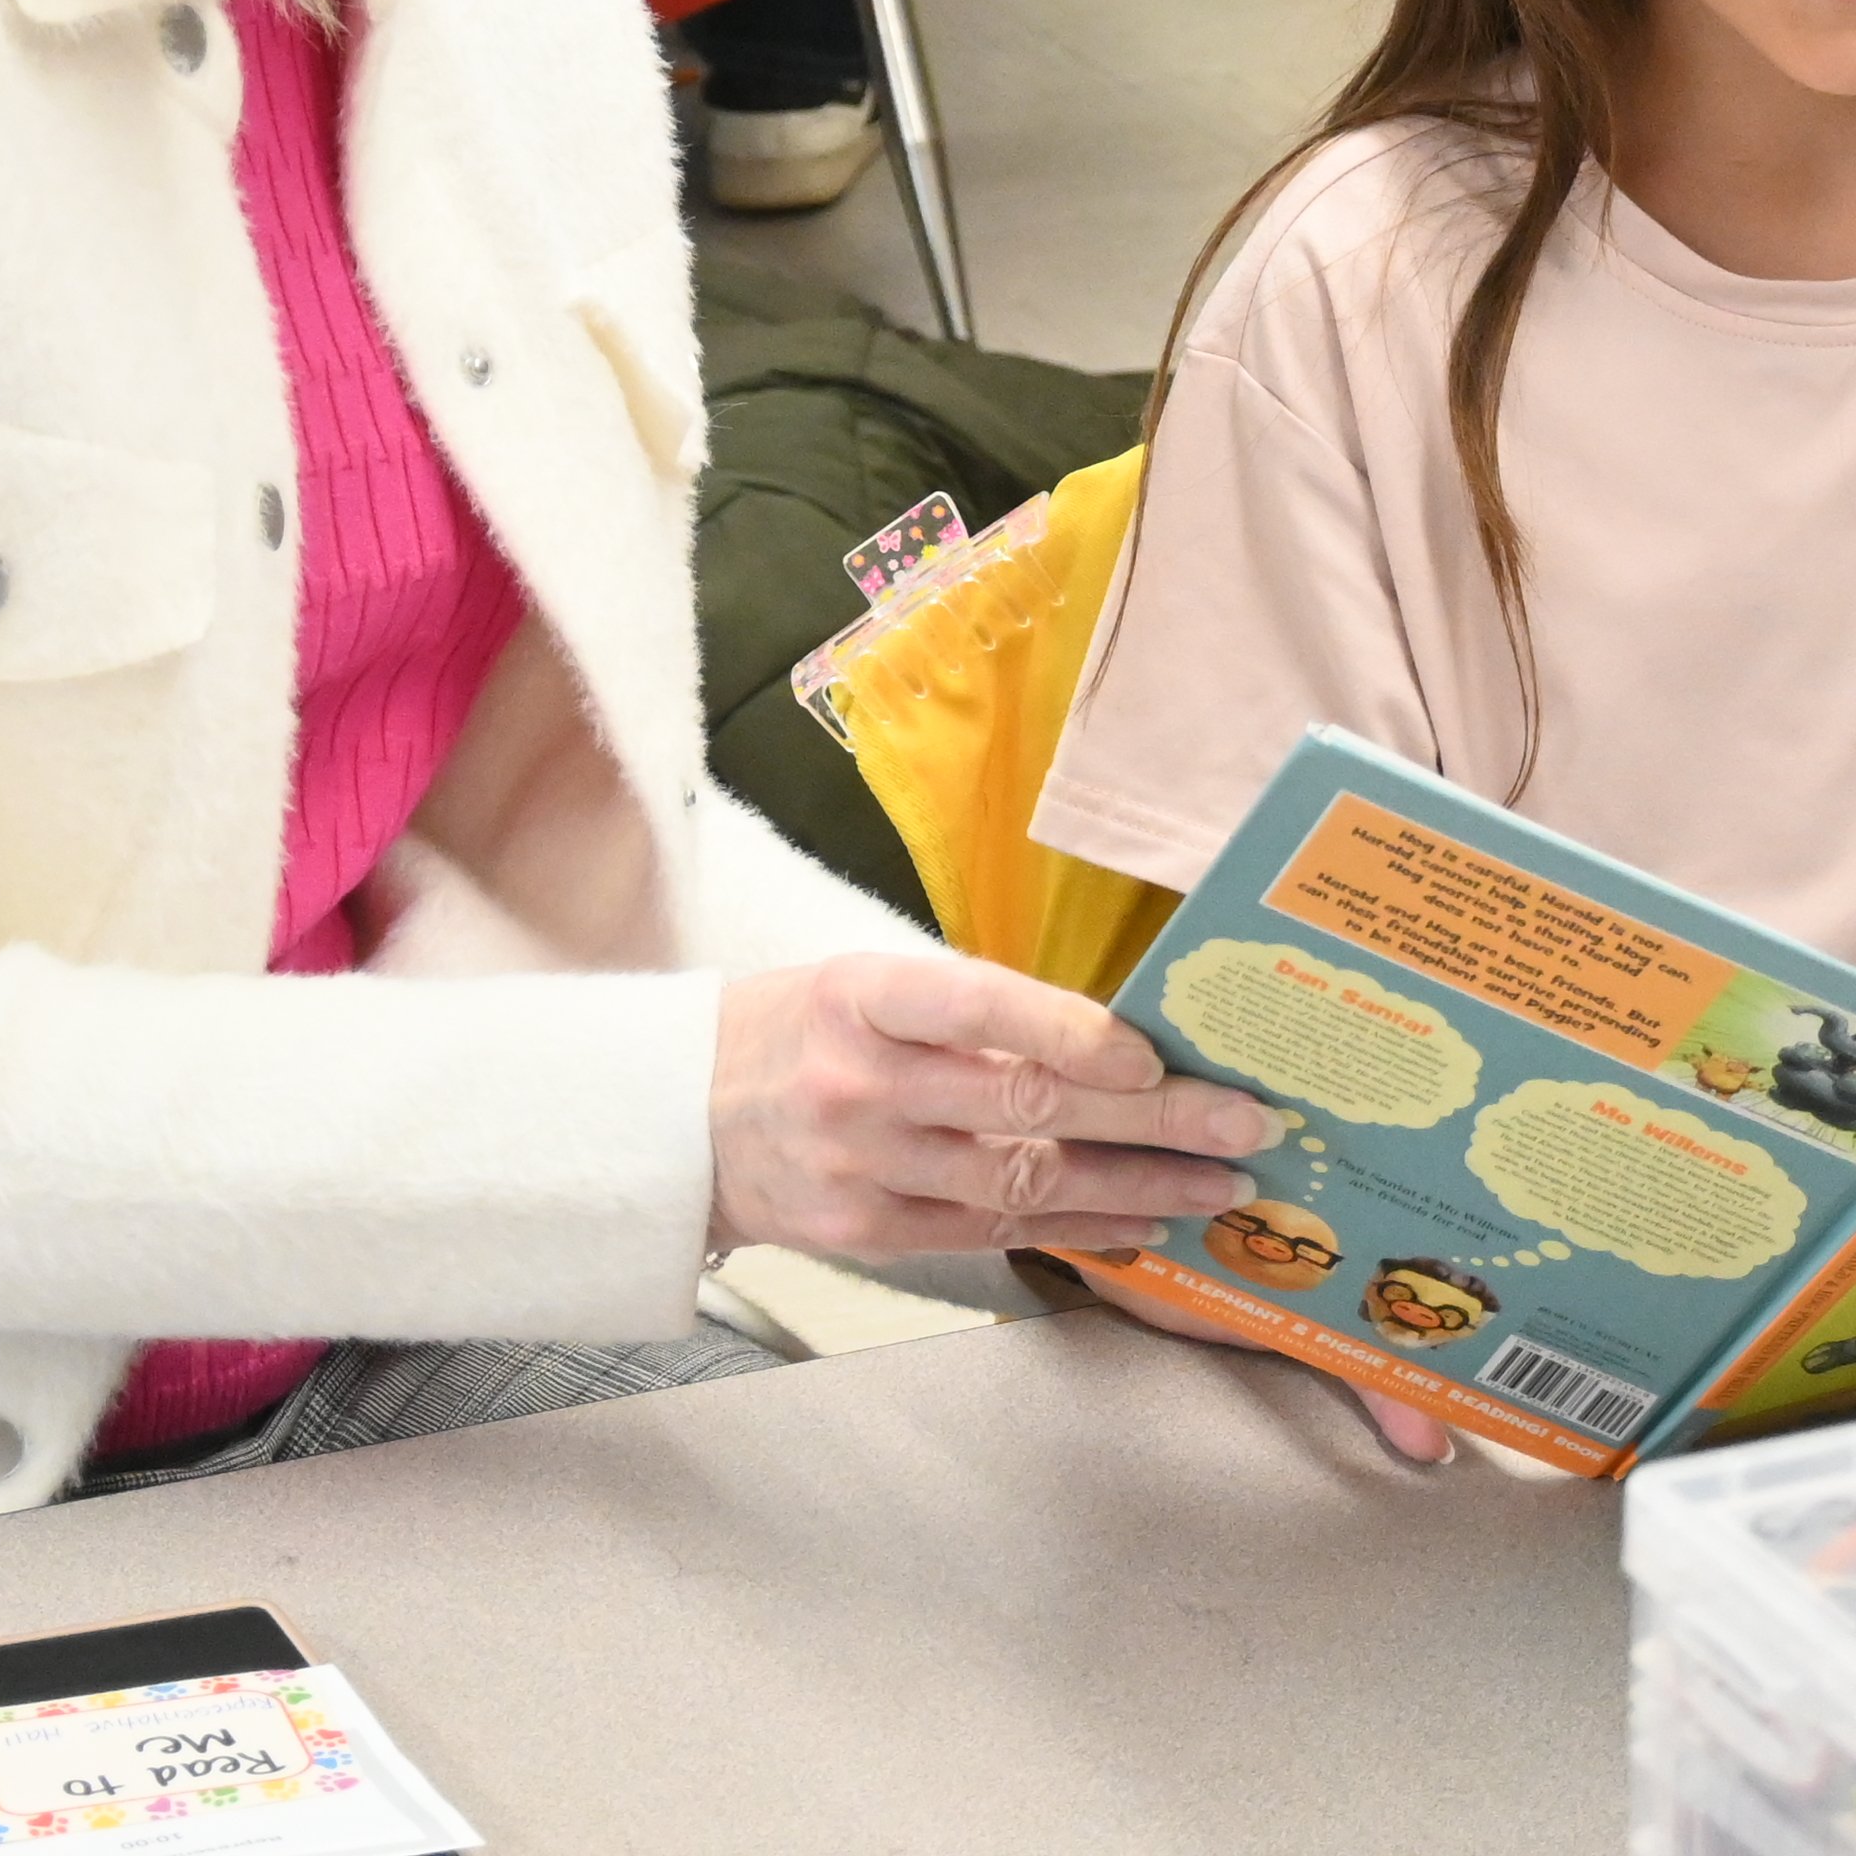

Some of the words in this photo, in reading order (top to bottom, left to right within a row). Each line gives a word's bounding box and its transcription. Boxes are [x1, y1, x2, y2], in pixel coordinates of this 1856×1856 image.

[1351, 824, 1415, 861] Harold
[1419, 856, 1482, 891] cannot
[1486, 885, 1528, 913] help
[1532, 905, 1608, 949] smiling.
[1613, 941, 1652, 968] Hog
[1656, 962, 1694, 986] can.
[1385, 858, 1424, 885] Hog
[1429, 876, 1500, 916] worries
[1504, 911, 1528, 928] so
[1532, 922, 1574, 949] that
[1578, 943, 1642, 979] Harold
[1397, 828, 1436, 855] Hog
[1441, 847, 1459, 863] is
[1463, 857, 1535, 897] careful.
[1539, 891, 1604, 928] Harold
[1607, 921, 1626, 938] is
[1630, 931, 1669, 957] not.
[1422, 891, 1467, 918] does
[1470, 914, 1503, 935] not
[1507, 929, 1555, 958] have
[1559, 953, 1584, 971] to.
[1296, 880, 1329, 901] can
[1335, 895, 1381, 923] their
[1384, 917, 1481, 971] friendship
[1484, 963, 1556, 1002] survive
[1559, 996, 1662, 1051] pretending
[1316, 870, 1379, 905] Harold
[1383, 899, 1421, 924] and
[1423, 918, 1463, 945] Hog
[1467, 938, 1498, 959] are
[1503, 953, 1545, 979] best
[1549, 973, 1621, 1013] friends.
[1626, 1007, 1662, 1031] But
[1344, 917, 1364, 933] to
[1368, 927, 1392, 946] be
[1396, 940, 1479, 986] Elephant
[1482, 978, 1520, 1002] and
[1523, 996, 1595, 1039] Piggie?
[1273, 957, 1331, 993] Dan
[1338, 985, 1437, 1040] Santat
[1588, 1098, 1635, 1129] Mo
[1641, 1119, 1750, 1178] Willems
[1336, 1156, 1366, 1176] Dan
[1368, 1171, 1418, 1199] Santat
[1419, 1193, 1432, 1204] &
[1435, 1200, 1458, 1216] Mo
[1463, 1211, 1520, 1243] Willems
[1139, 1258, 1167, 1277] AN
[1172, 1271, 1286, 1328] ELEPHANT
[1290, 1321, 1307, 1337] &
[1313, 1330, 1387, 1371] PIGGIE
[1391, 1363, 1443, 1394] LIKE
[1446, 1387, 1550, 1440] READING!
[1552, 1433, 1606, 1465] BOOK
[85, 1695, 275, 1734] Representative
[135, 1729, 236, 1754] Me
[62, 1775, 124, 1796] to
[146, 1750, 286, 1787] Read
[121, 1831, 183, 1850] 10:00
